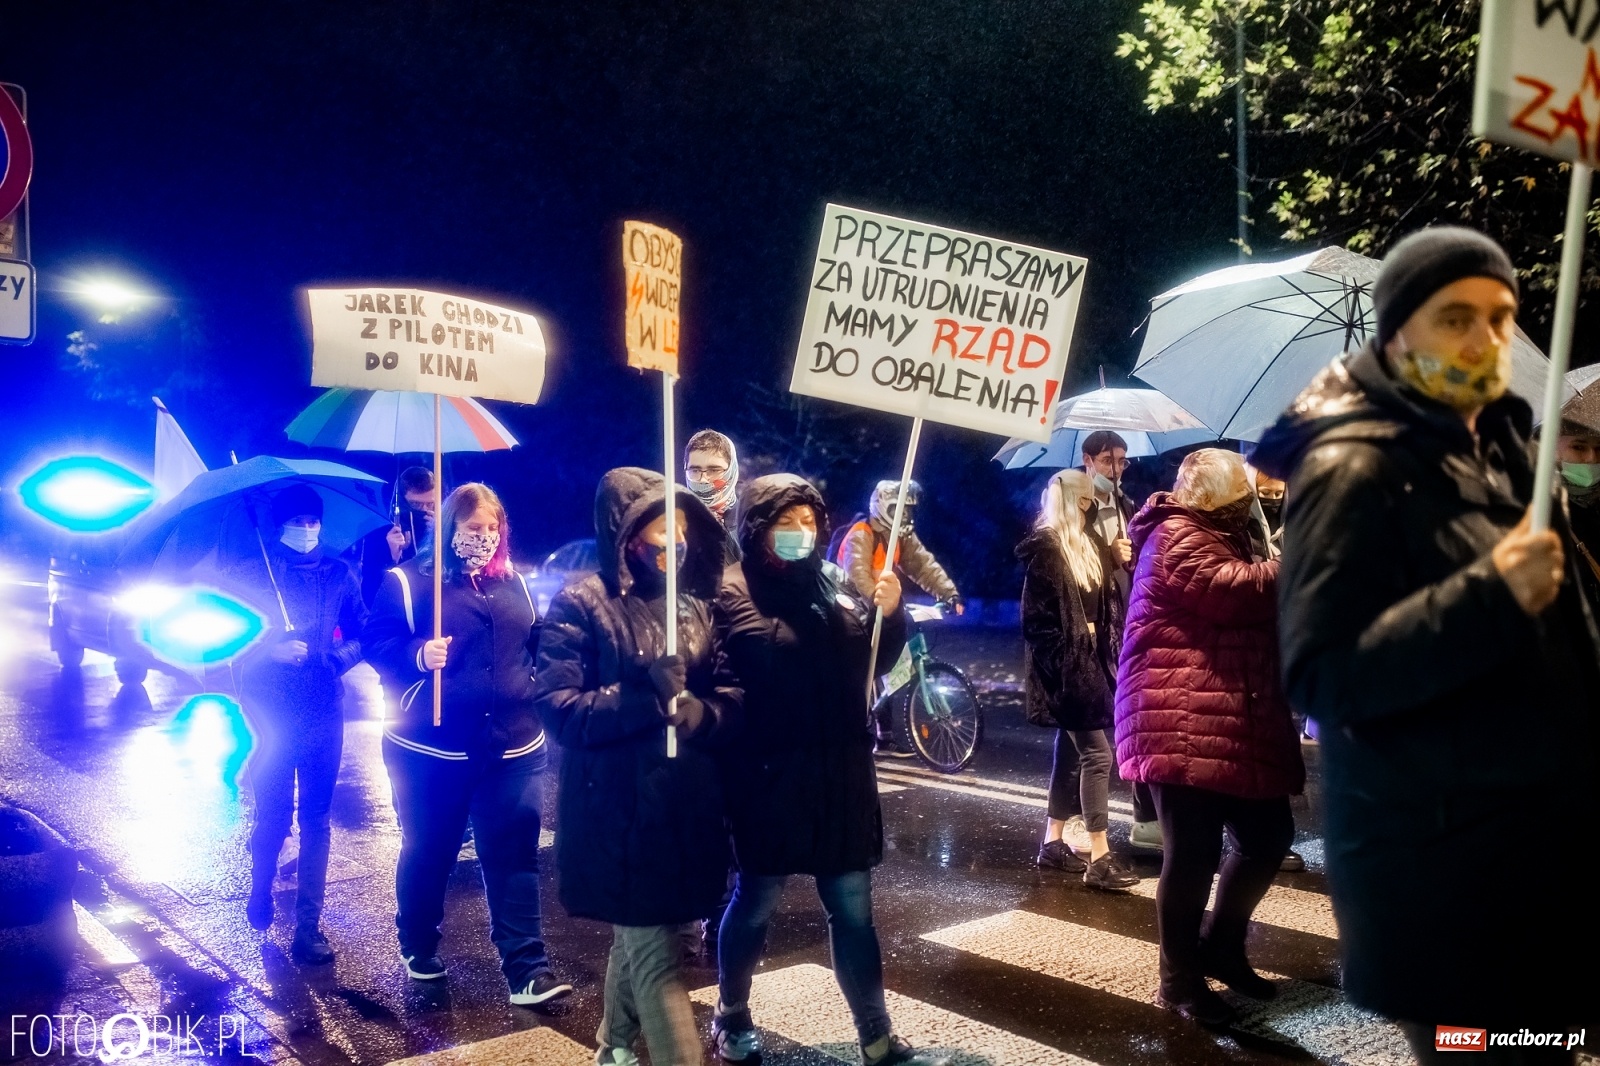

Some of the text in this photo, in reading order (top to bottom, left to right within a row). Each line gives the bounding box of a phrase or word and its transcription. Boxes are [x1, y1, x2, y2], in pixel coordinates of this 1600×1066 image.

[833, 214, 1085, 299] PRZEPRASZAMY
[344, 293, 524, 335] JAREK CHODZI
[814, 258, 1049, 330] ZA UTRUDNIENIA
[361, 318, 495, 354] Z PILOTEM
[639, 313, 657, 351] W
[823, 301, 1052, 374] MAMY RZĄD
[365, 351, 478, 383] DO KINA
[809, 341, 1059, 425] DO OBALENIA!
